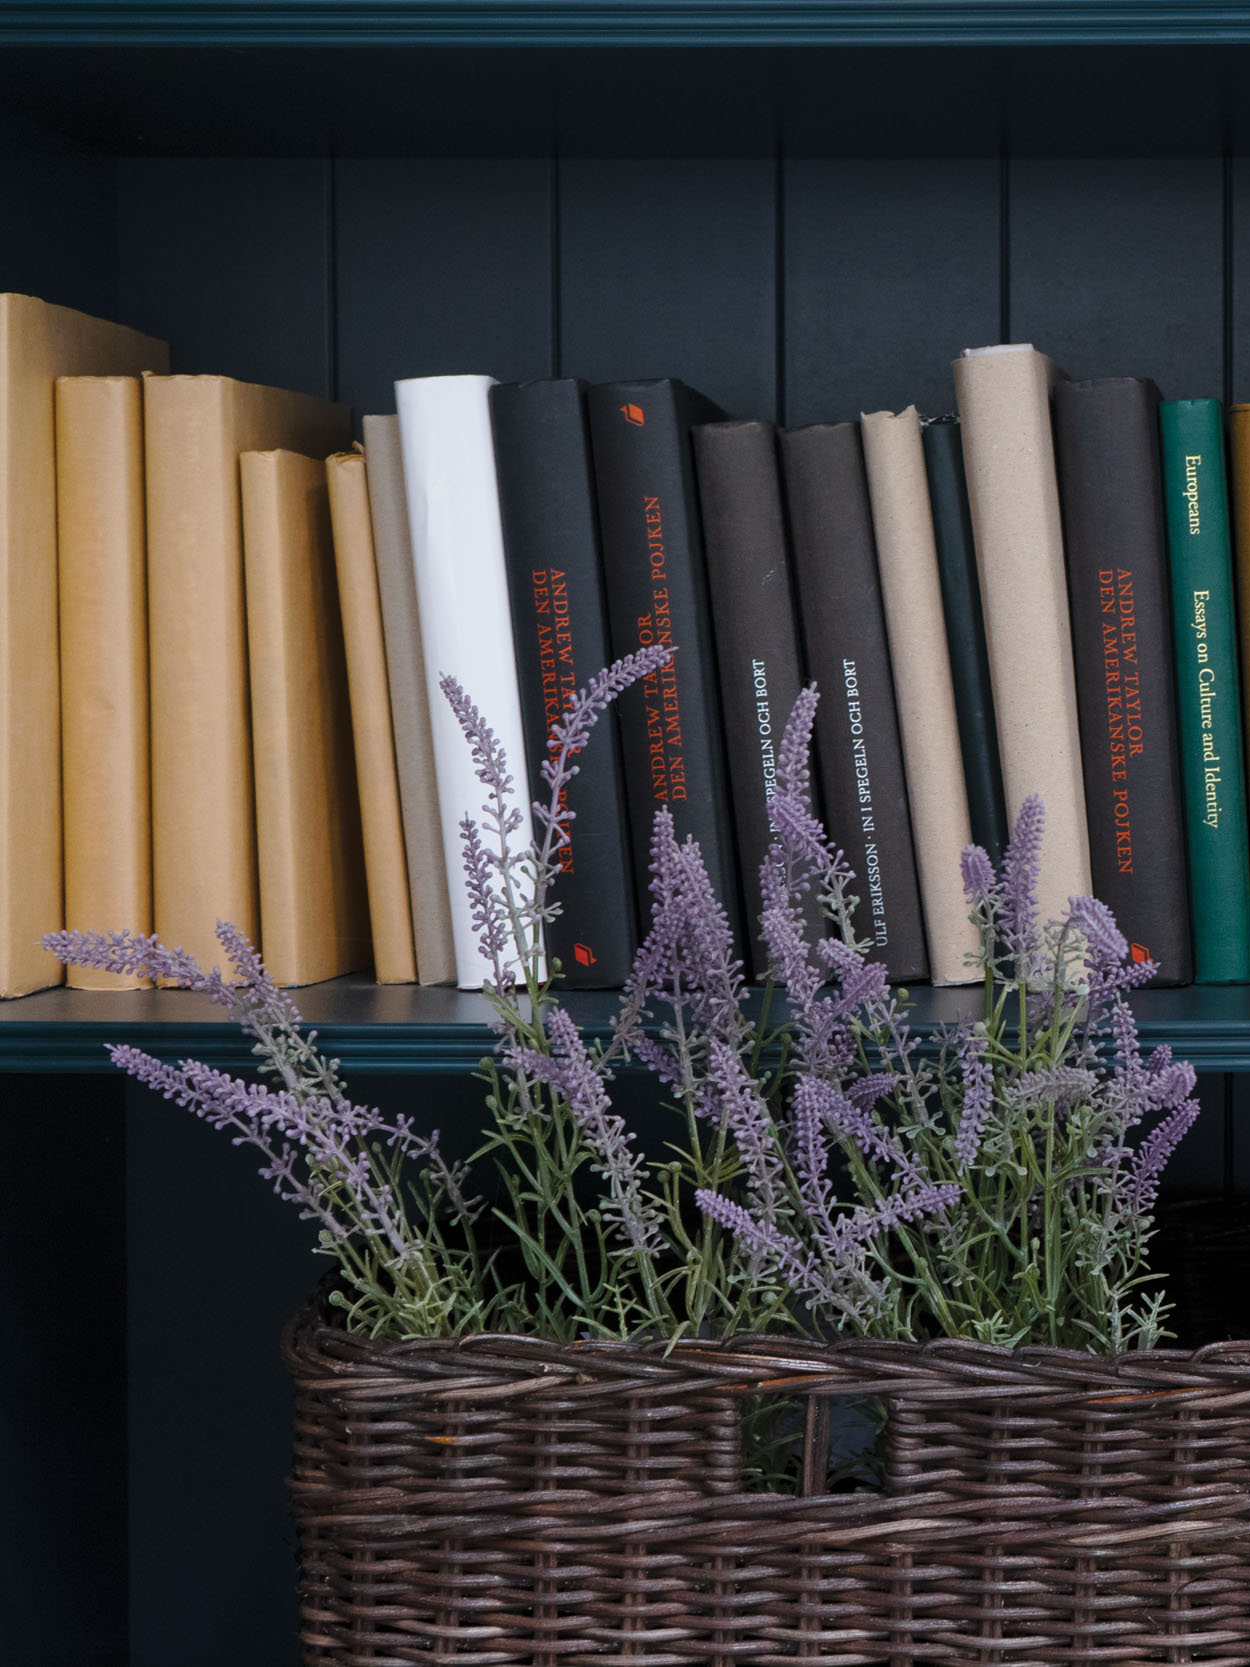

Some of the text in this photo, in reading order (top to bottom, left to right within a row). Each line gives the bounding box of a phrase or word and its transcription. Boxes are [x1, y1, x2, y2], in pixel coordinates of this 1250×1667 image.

[1182, 455, 1202, 535] Europeans
[532, 569, 550, 614] DEN
[550, 568, 582, 759] ANDREW TAYR
[645, 496, 688, 801] DEN AMERIKNSKE POJKEN
[753, 658, 769, 698] BORT
[843, 658, 859, 698] BORT
[1116, 567, 1144, 758] ANDREW TAYLOR
[637, 612, 670, 801] ANDREW TAOR
[757, 701, 773, 736] OCH
[848, 700, 864, 735] OCH
[1098, 570, 1134, 873] DEN AMERIKANSKE POJKEN
[1190, 589, 1222, 829] Essays on Culture and Identity
[853, 738, 872, 803] SPEGELN
[861, 816, 876, 832] IN
[865, 843, 885, 915] ERIKSSON
[875, 919, 888, 947] ULF
